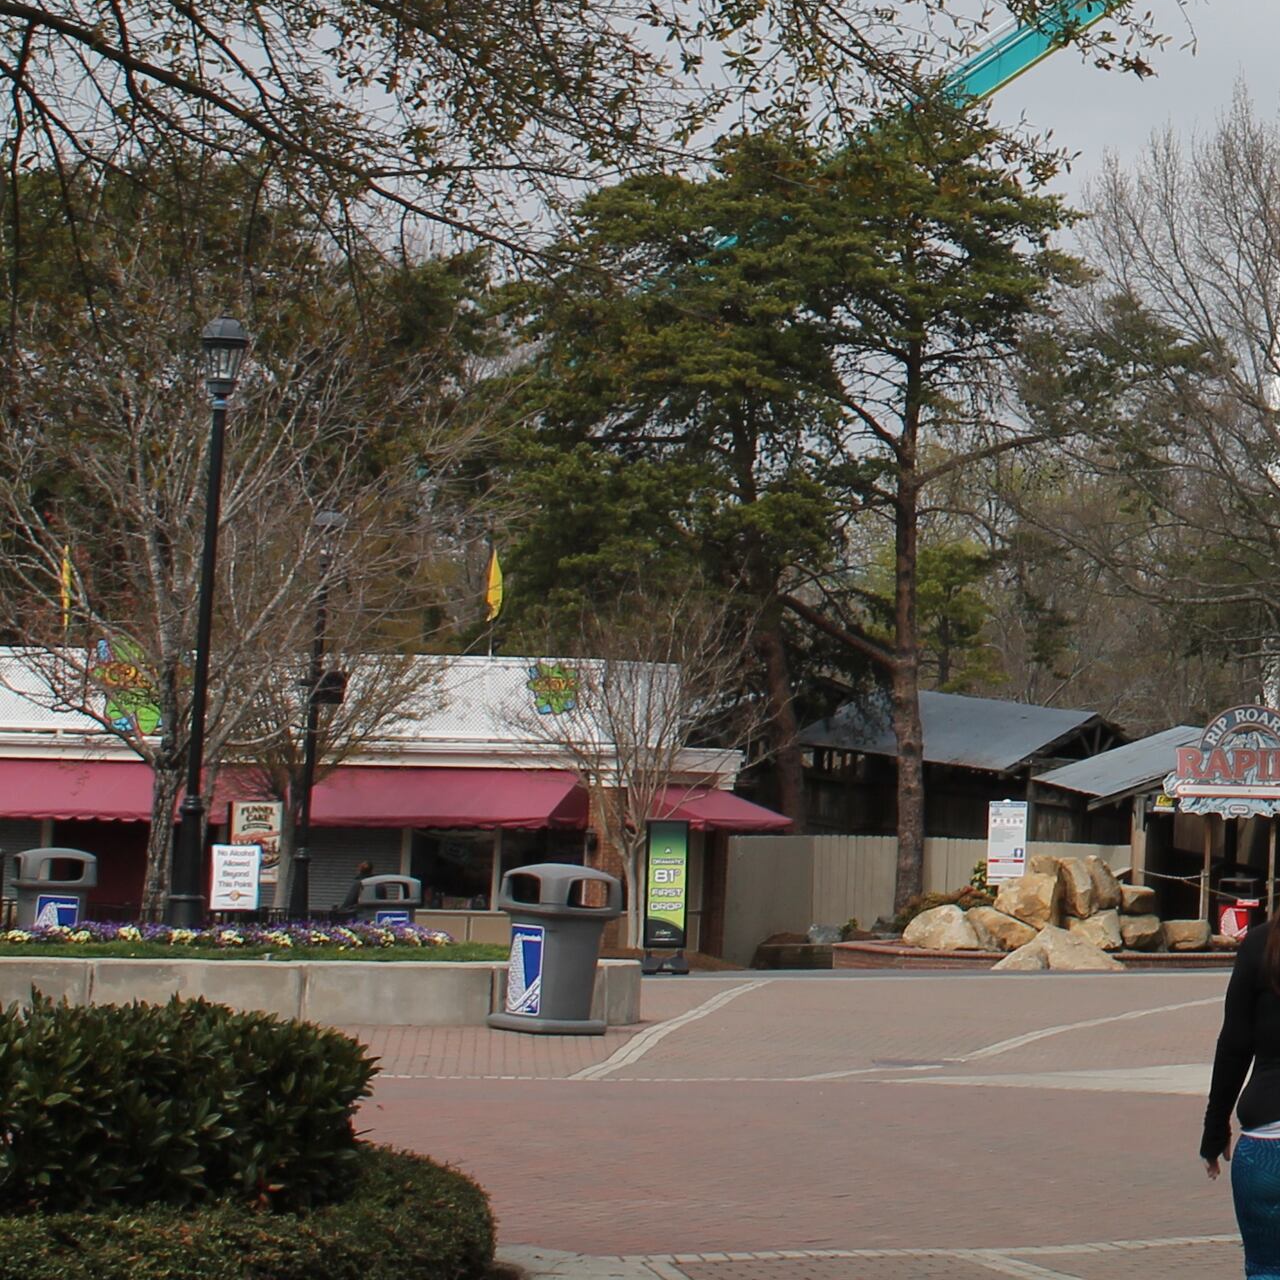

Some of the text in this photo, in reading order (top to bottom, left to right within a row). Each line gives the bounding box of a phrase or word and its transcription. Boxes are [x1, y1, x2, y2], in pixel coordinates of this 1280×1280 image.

[1205, 717, 1228, 746] RIP
[241, 805, 275, 816] FUNNEL
[246, 813, 270, 822] CAKE
[223, 859, 250, 867] Allowed
[223, 870, 250, 879] Beyond
[218, 880, 254, 888] This Point
[651, 888, 683, 897] FIRST
[650, 902, 683, 911] DROP
